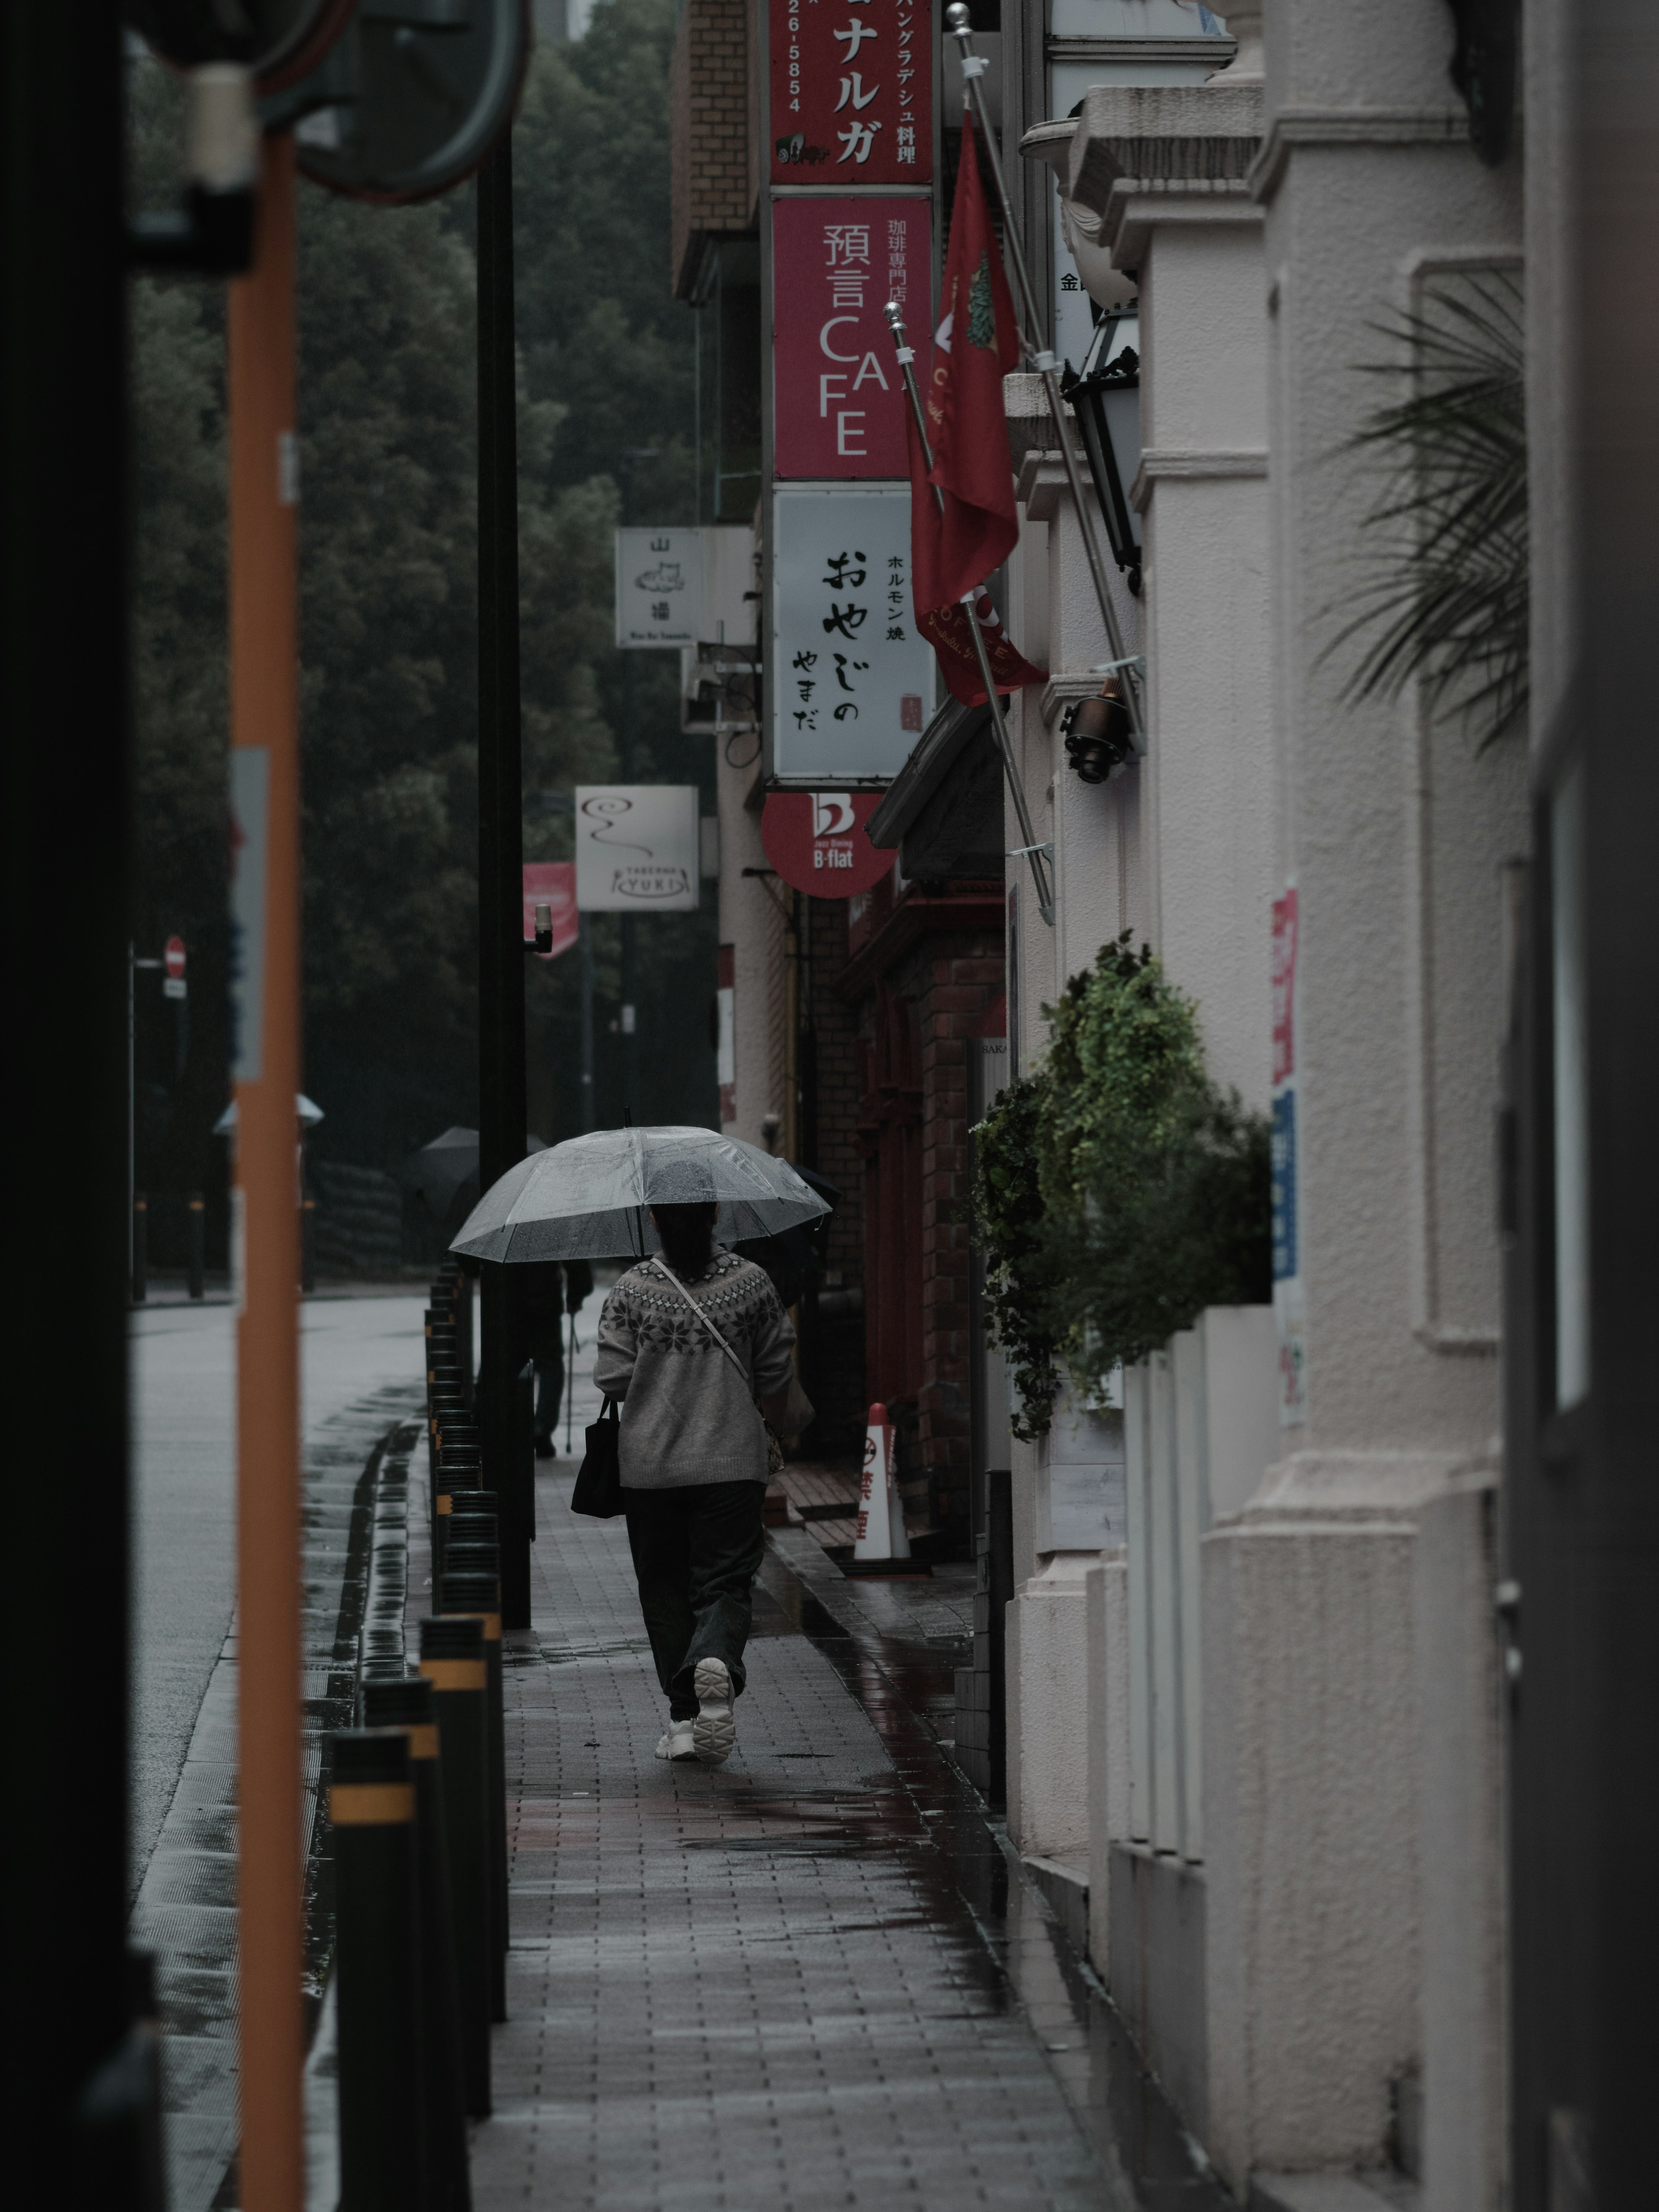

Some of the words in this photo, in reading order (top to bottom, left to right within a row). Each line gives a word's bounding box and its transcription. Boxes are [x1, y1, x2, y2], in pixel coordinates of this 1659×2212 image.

[834, 0, 882, 164] ナルガ
[823, 552, 869, 721] おやじの
[886, 556, 906, 641] ホルモン焼
[793, 651, 818, 731] やまだ
[629, 878, 674, 891] YUKI
